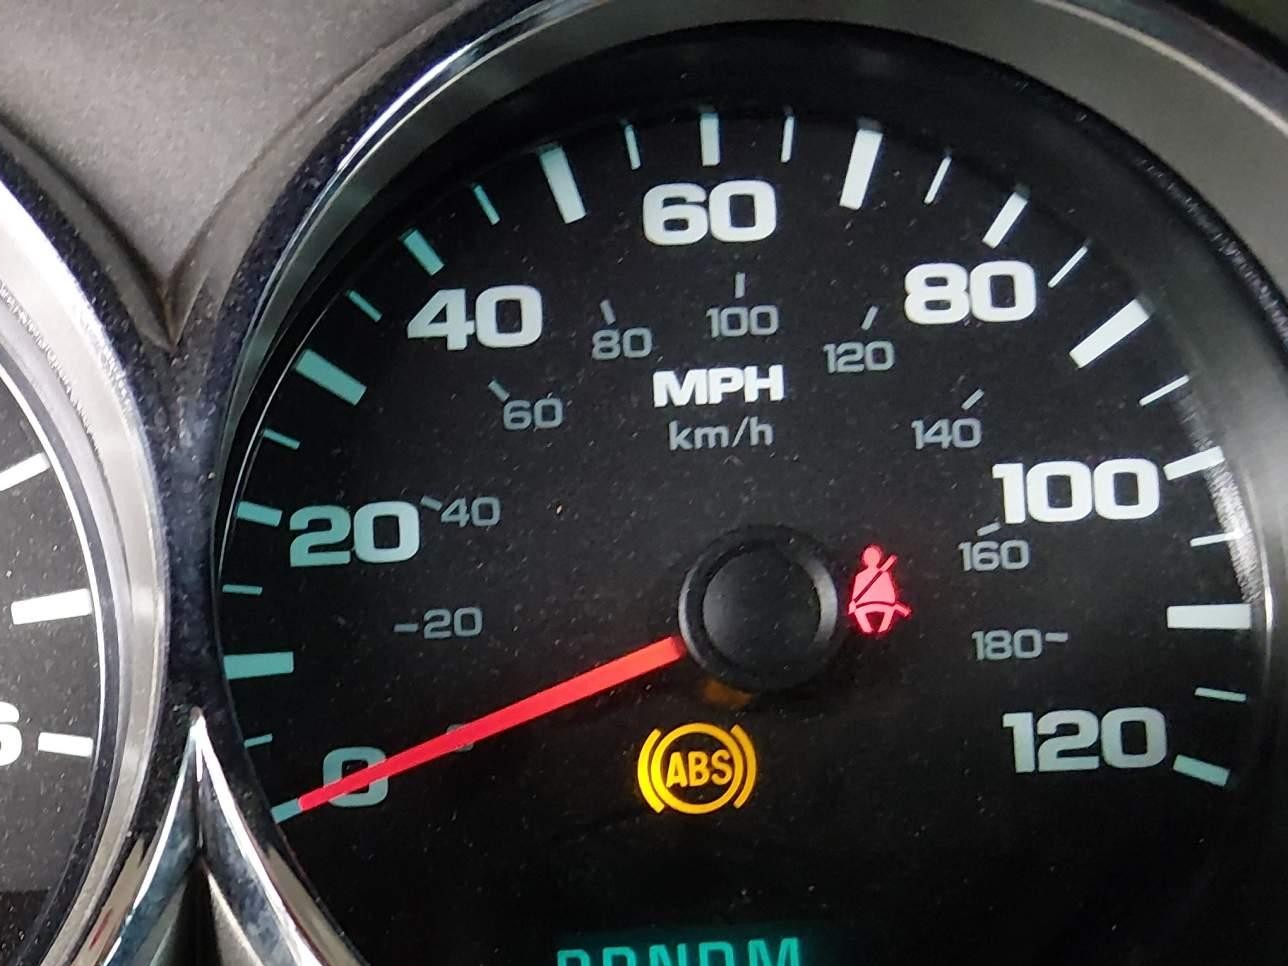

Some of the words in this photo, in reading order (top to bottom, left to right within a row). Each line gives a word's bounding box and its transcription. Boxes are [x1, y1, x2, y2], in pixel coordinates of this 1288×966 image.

[643, 180, 777, 245] 60
[905, 261, 1037, 324] 80
[407, 285, 543, 350] 40
[705, 305, 778, 337] 100
[592, 328, 652, 359] 80
[823, 340, 894, 373] 120
[653, 364, 784, 408] MPH
[503, 399, 563, 429] 60
[669, 417, 773, 451] km/h
[912, 418, 982, 449] 140
[992, 459, 1159, 523] 100
[440, 497, 500, 527] 40
[289, 501, 420, 567] 20
[959, 540, 1030, 571] 160
[424, 607, 483, 638] 20
[972, 629, 1042, 660] 180
[1002, 707, 1167, 773] 120
[323, 746, 388, 807] 0
[666, 749, 732, 788] ABS
